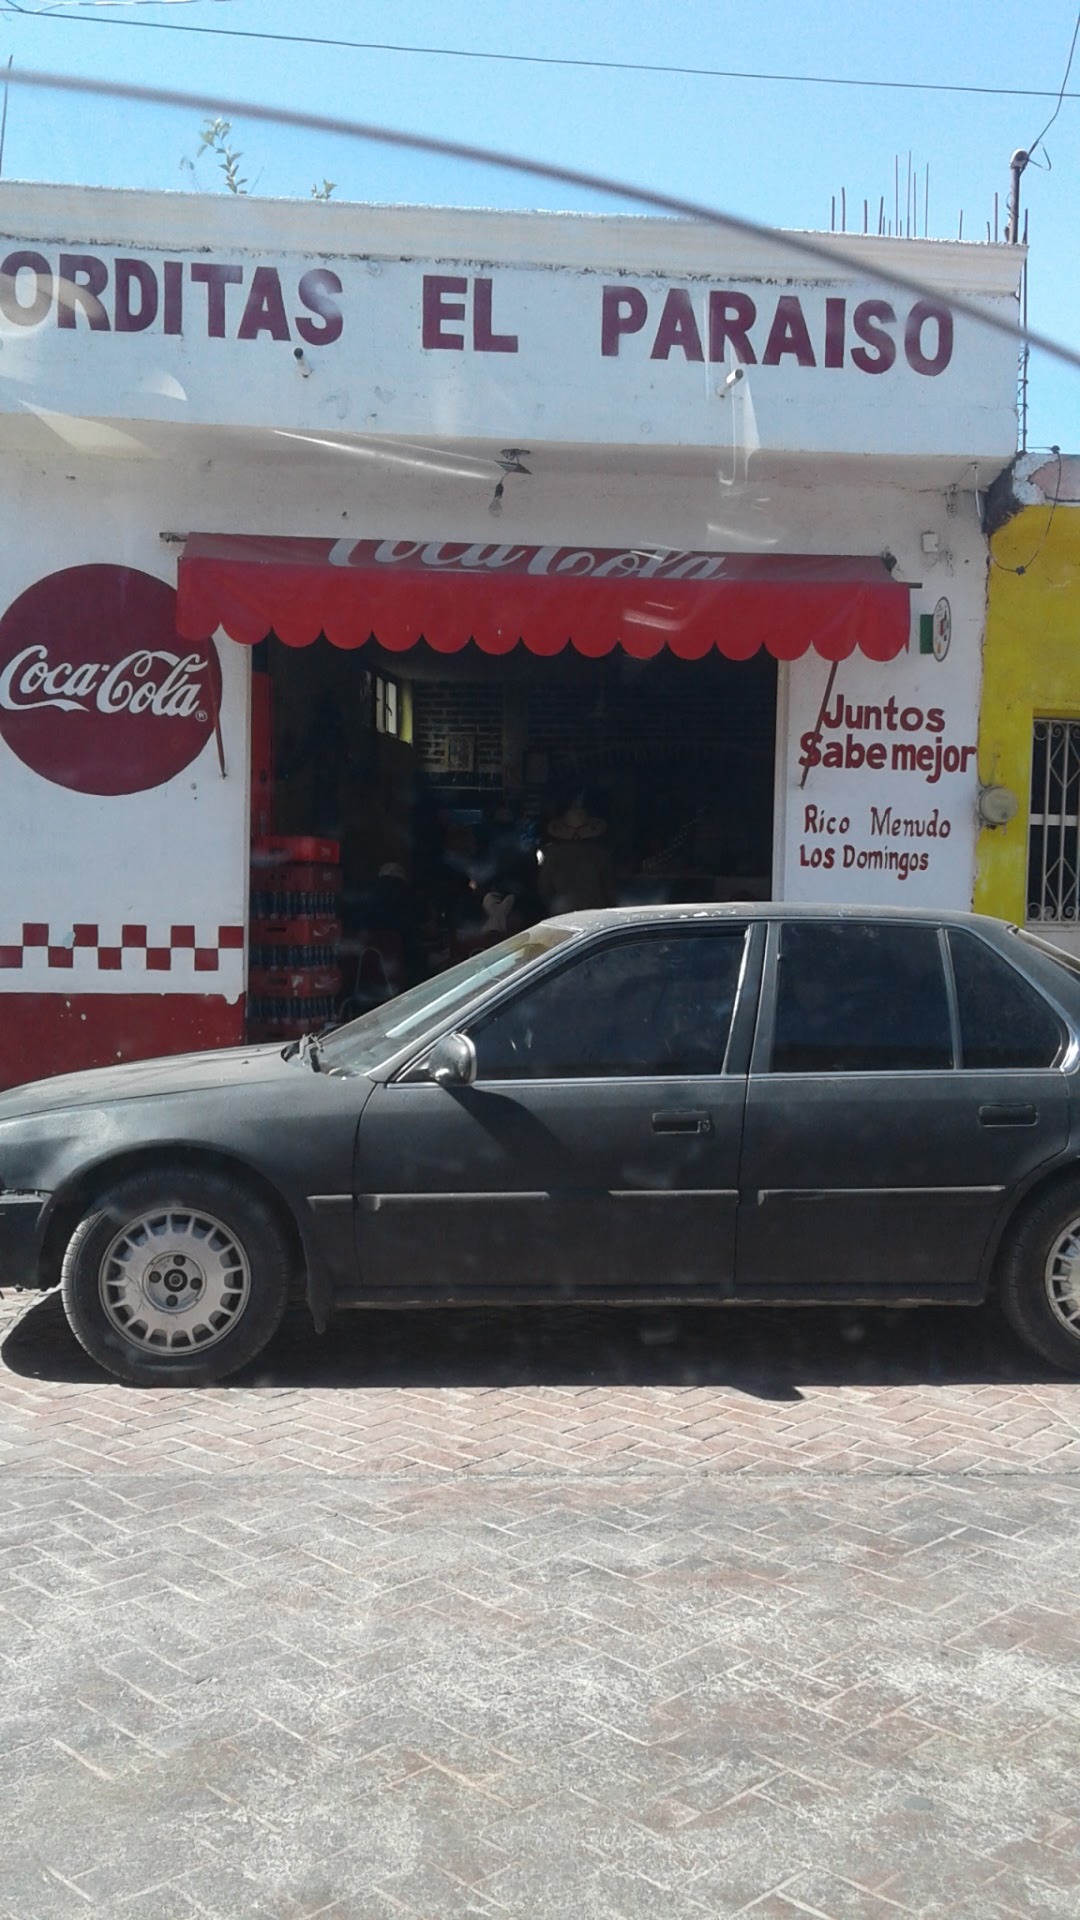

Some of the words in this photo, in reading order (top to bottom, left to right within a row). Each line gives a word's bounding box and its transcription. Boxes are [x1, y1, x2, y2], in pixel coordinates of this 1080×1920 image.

[0, 250, 344, 346] ORDITAS
[422, 274, 519, 353] EL
[601, 285, 954, 377] PARAISO
[0, 644, 209, 717] Coca-Cola
[822, 694, 946, 733] Juntos
[798, 731, 888, 769] Sabe
[891, 736, 977, 784] mejor
[804, 804, 850, 835] Rico
[870, 806, 951, 838] Menudo
[799, 844, 836, 869] Los
[842, 844, 929, 880] Domingos
